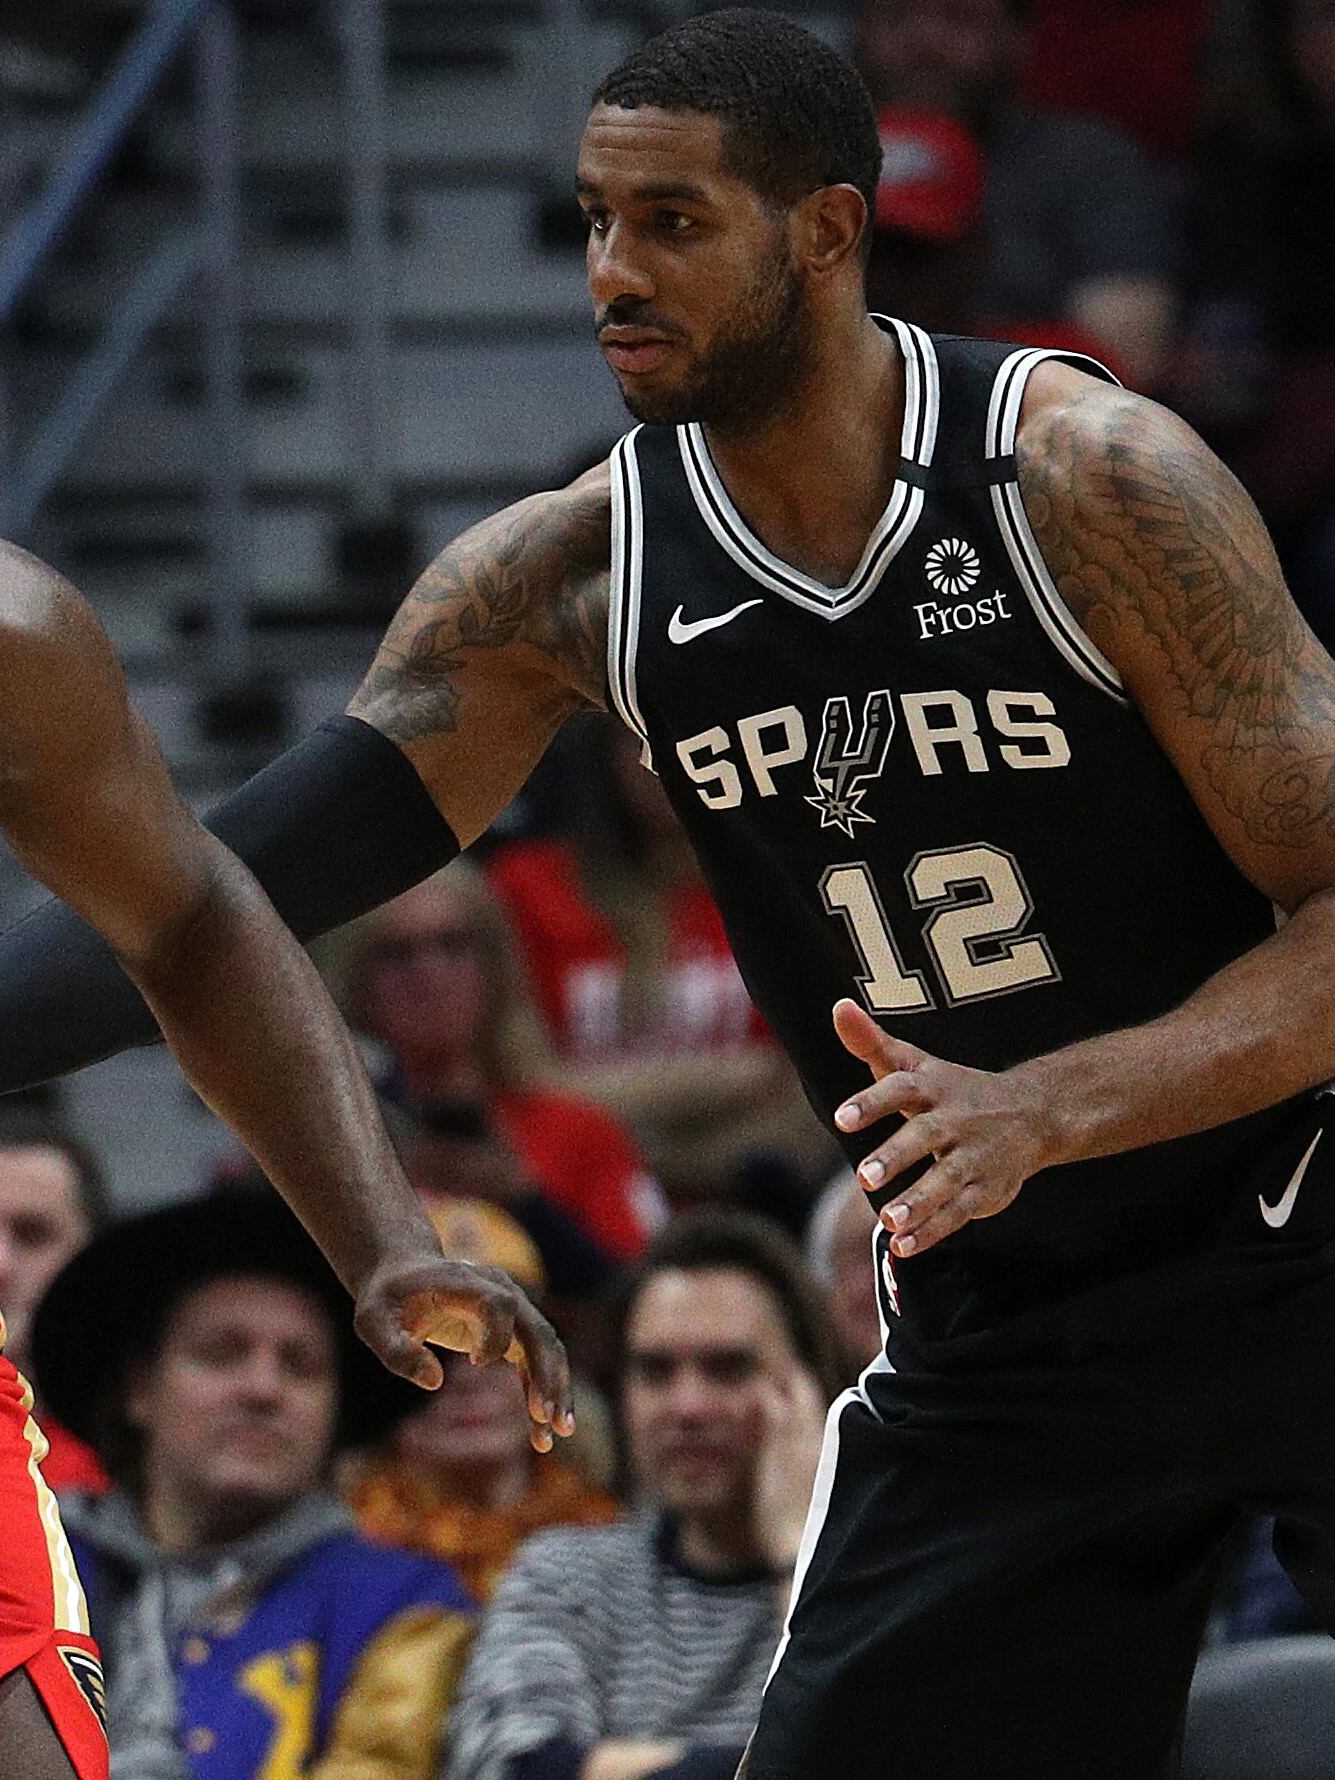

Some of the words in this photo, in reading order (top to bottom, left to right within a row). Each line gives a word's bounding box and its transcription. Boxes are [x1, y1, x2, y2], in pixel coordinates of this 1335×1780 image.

[912, 589, 1012, 640] Frost
[675, 688, 1072, 839] SPURS
[817, 841, 1062, 1015] 12
